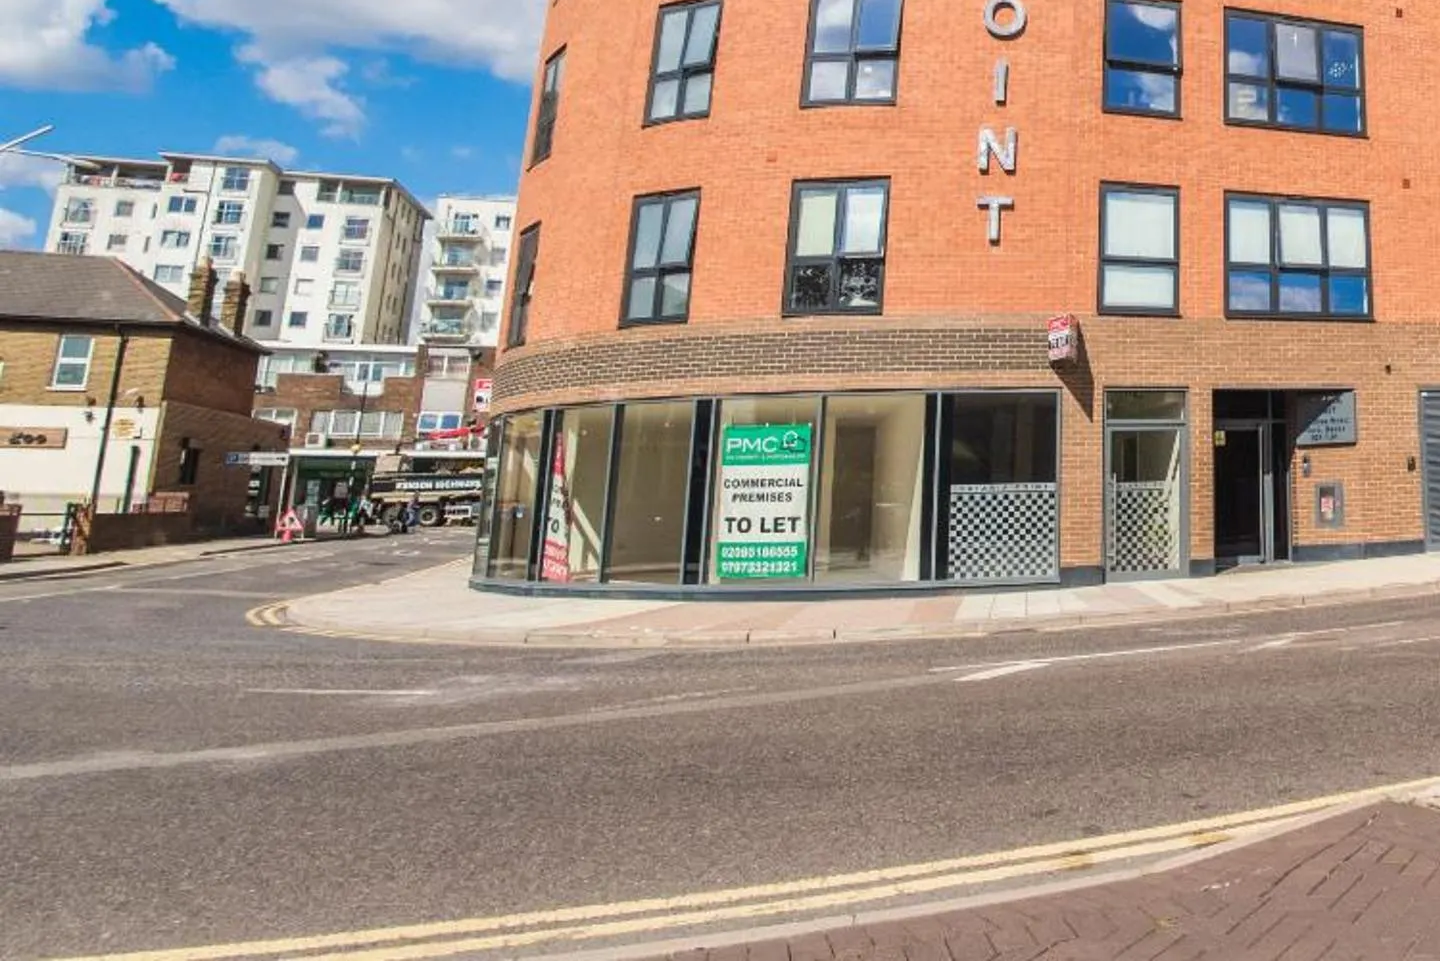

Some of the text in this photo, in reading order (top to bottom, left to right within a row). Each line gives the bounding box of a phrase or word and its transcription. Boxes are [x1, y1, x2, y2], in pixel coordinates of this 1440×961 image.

[726, 436, 779, 453] PMC
[724, 477, 804, 489] COMMERCIAL
[731, 491, 793, 503] PREMISES
[724, 516, 802, 533] TO LET
